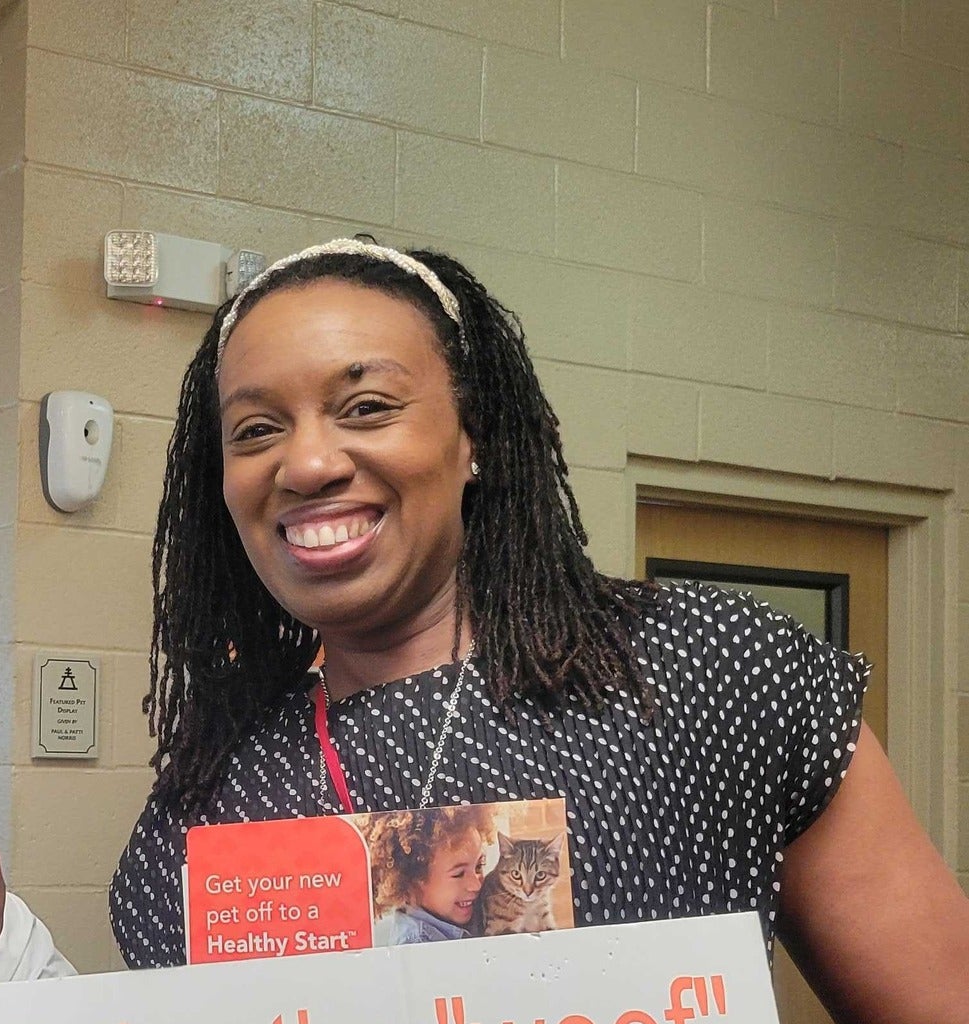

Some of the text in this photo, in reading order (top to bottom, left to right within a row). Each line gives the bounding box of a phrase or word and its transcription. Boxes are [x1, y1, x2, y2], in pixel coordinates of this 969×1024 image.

[205, 872, 342, 897] Get your new
[206, 901, 320, 931] pet off to a
[206, 931, 289, 957] Healthy
